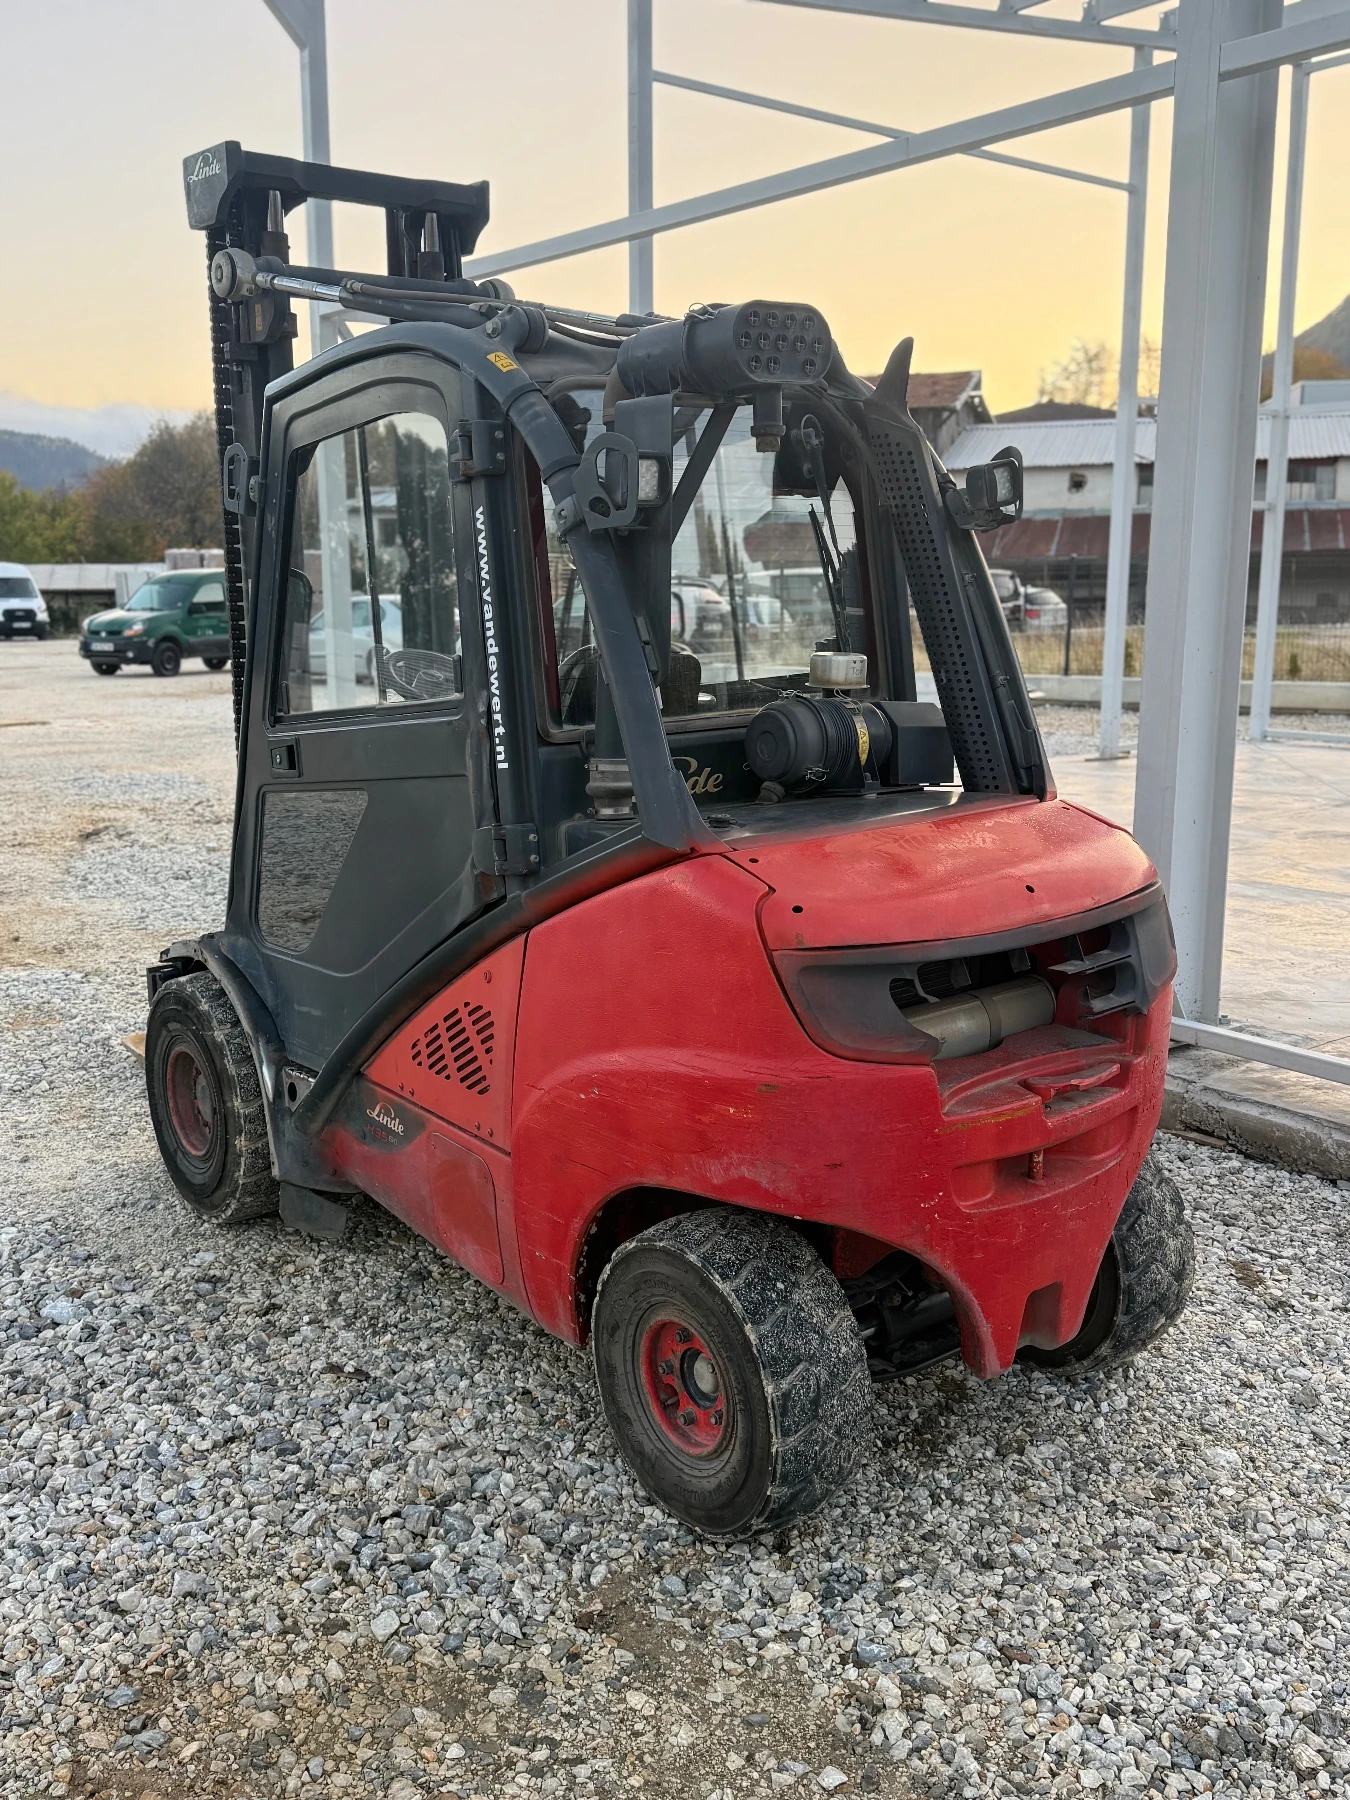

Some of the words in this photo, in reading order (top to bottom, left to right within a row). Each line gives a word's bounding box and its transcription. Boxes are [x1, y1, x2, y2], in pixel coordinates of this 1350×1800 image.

[188, 152, 222, 183] Linde
[475, 506, 509, 769] www.vandewert.nl
[366, 1101, 405, 1136] Linde
